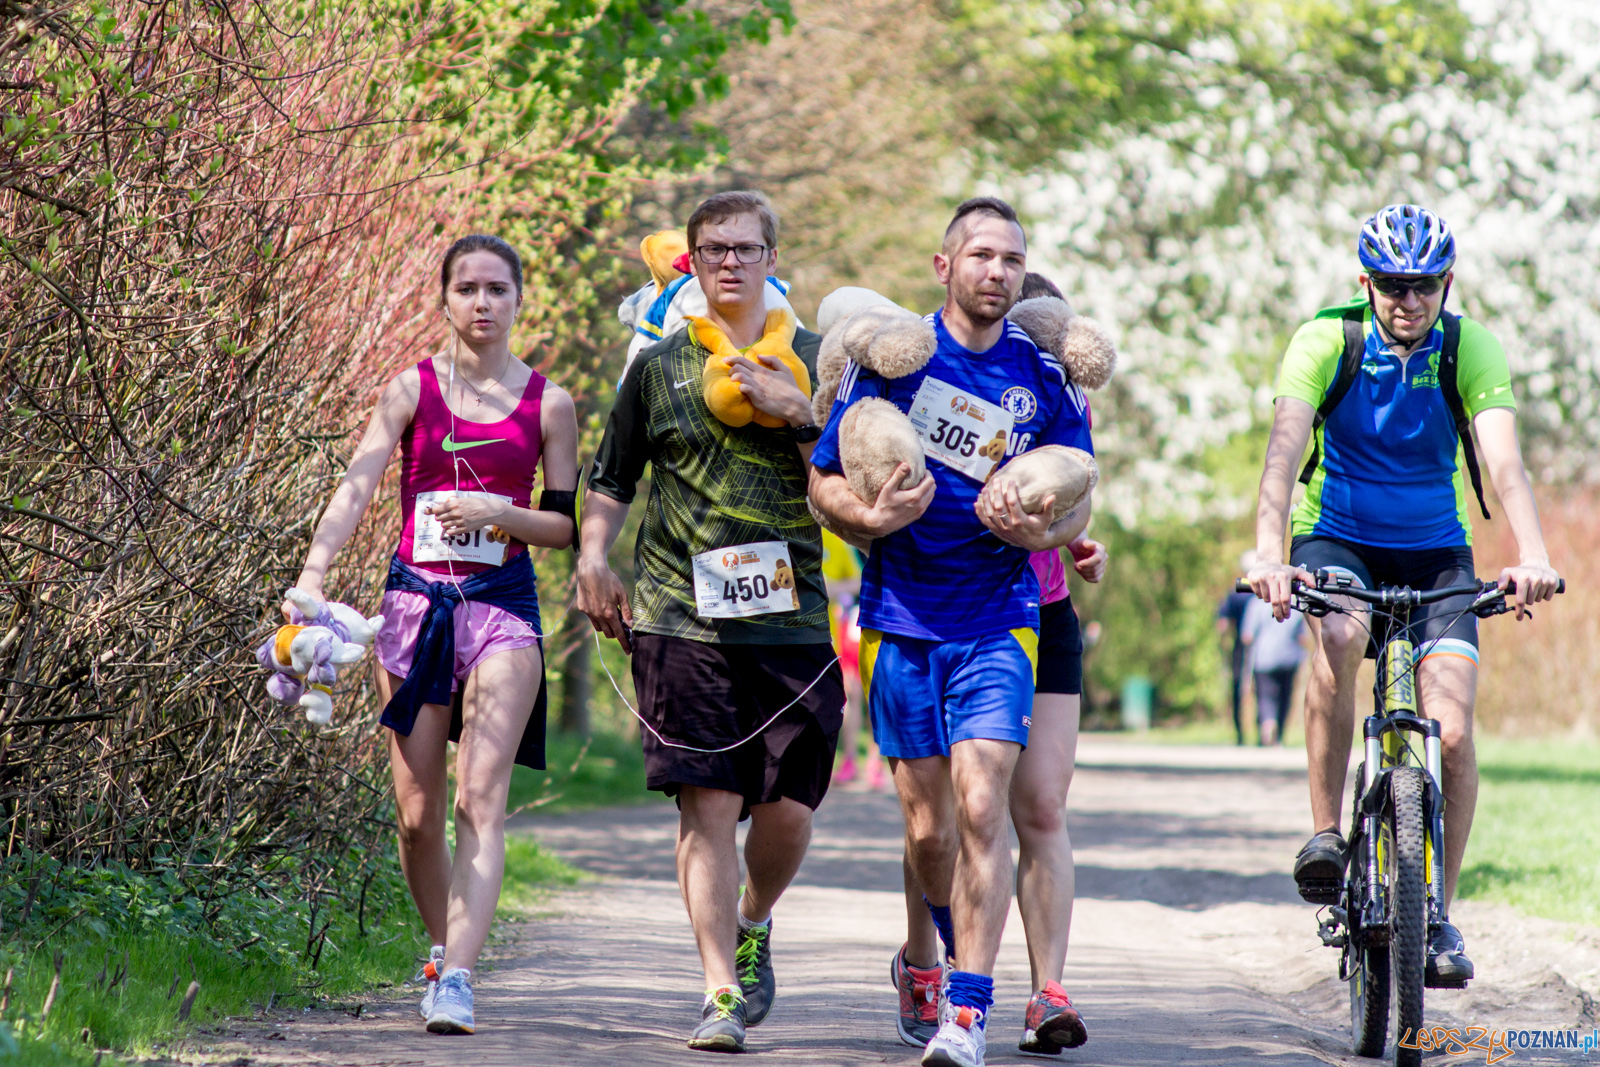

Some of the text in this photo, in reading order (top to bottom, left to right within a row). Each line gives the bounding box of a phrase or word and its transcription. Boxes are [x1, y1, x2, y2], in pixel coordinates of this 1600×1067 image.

[1008, 388, 1031, 399] CHELSEA
[929, 417, 981, 458] 305
[722, 574, 769, 604] 450
[1399, 645, 1412, 704] GIANT
